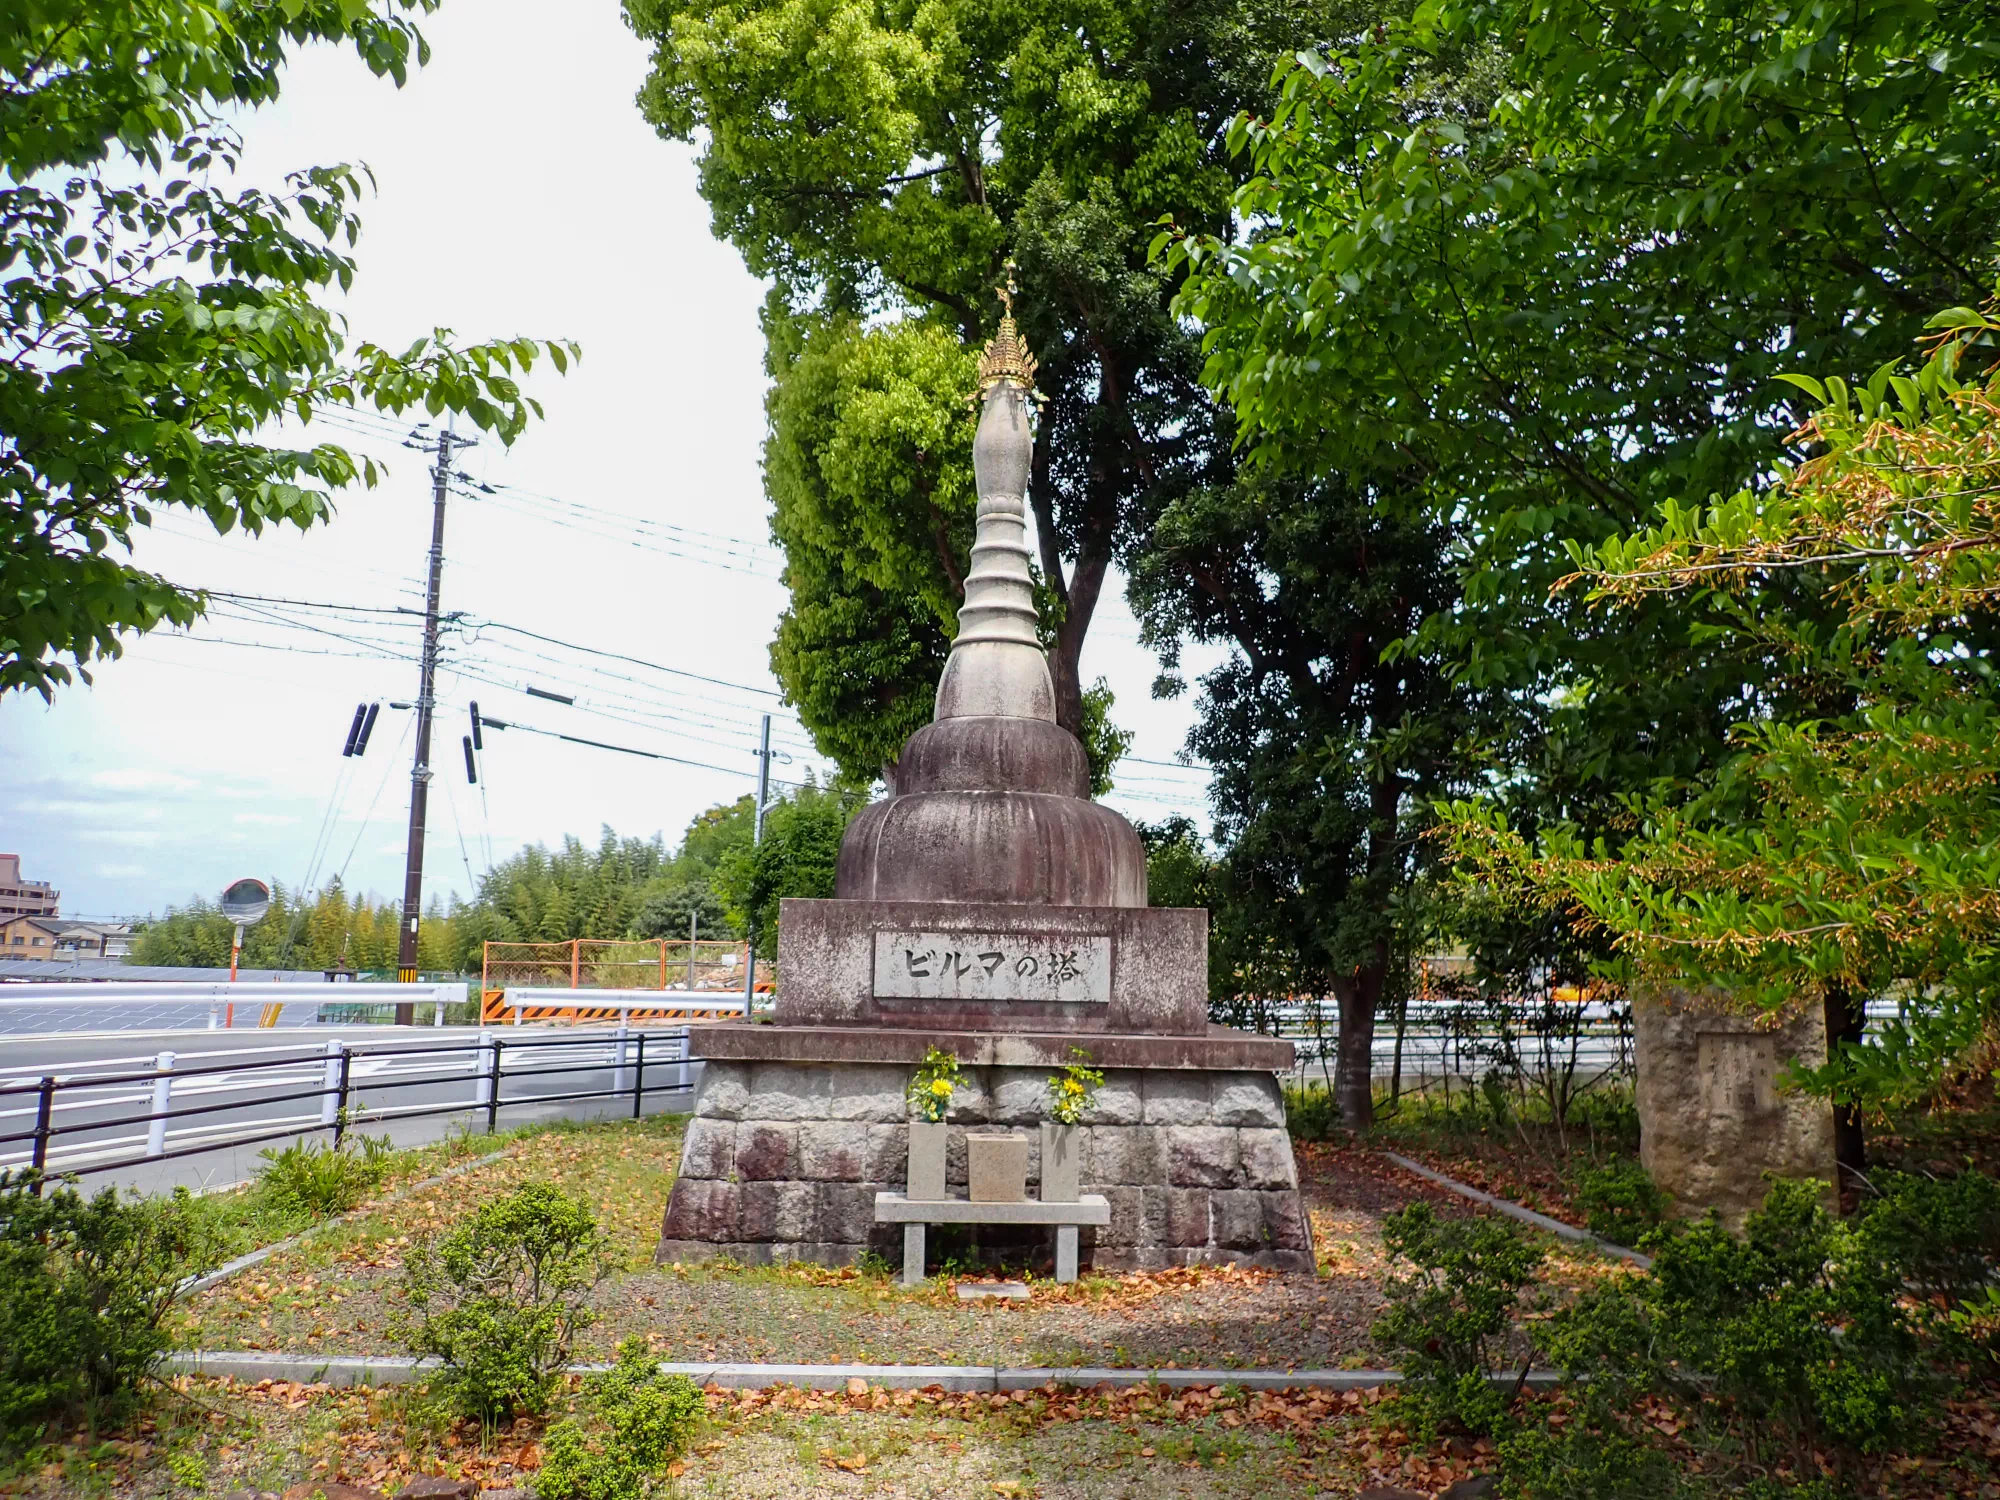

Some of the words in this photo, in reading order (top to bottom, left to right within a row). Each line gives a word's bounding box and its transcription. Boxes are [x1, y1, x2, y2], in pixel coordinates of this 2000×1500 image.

[905, 949, 1081, 983] ビルマの塔
